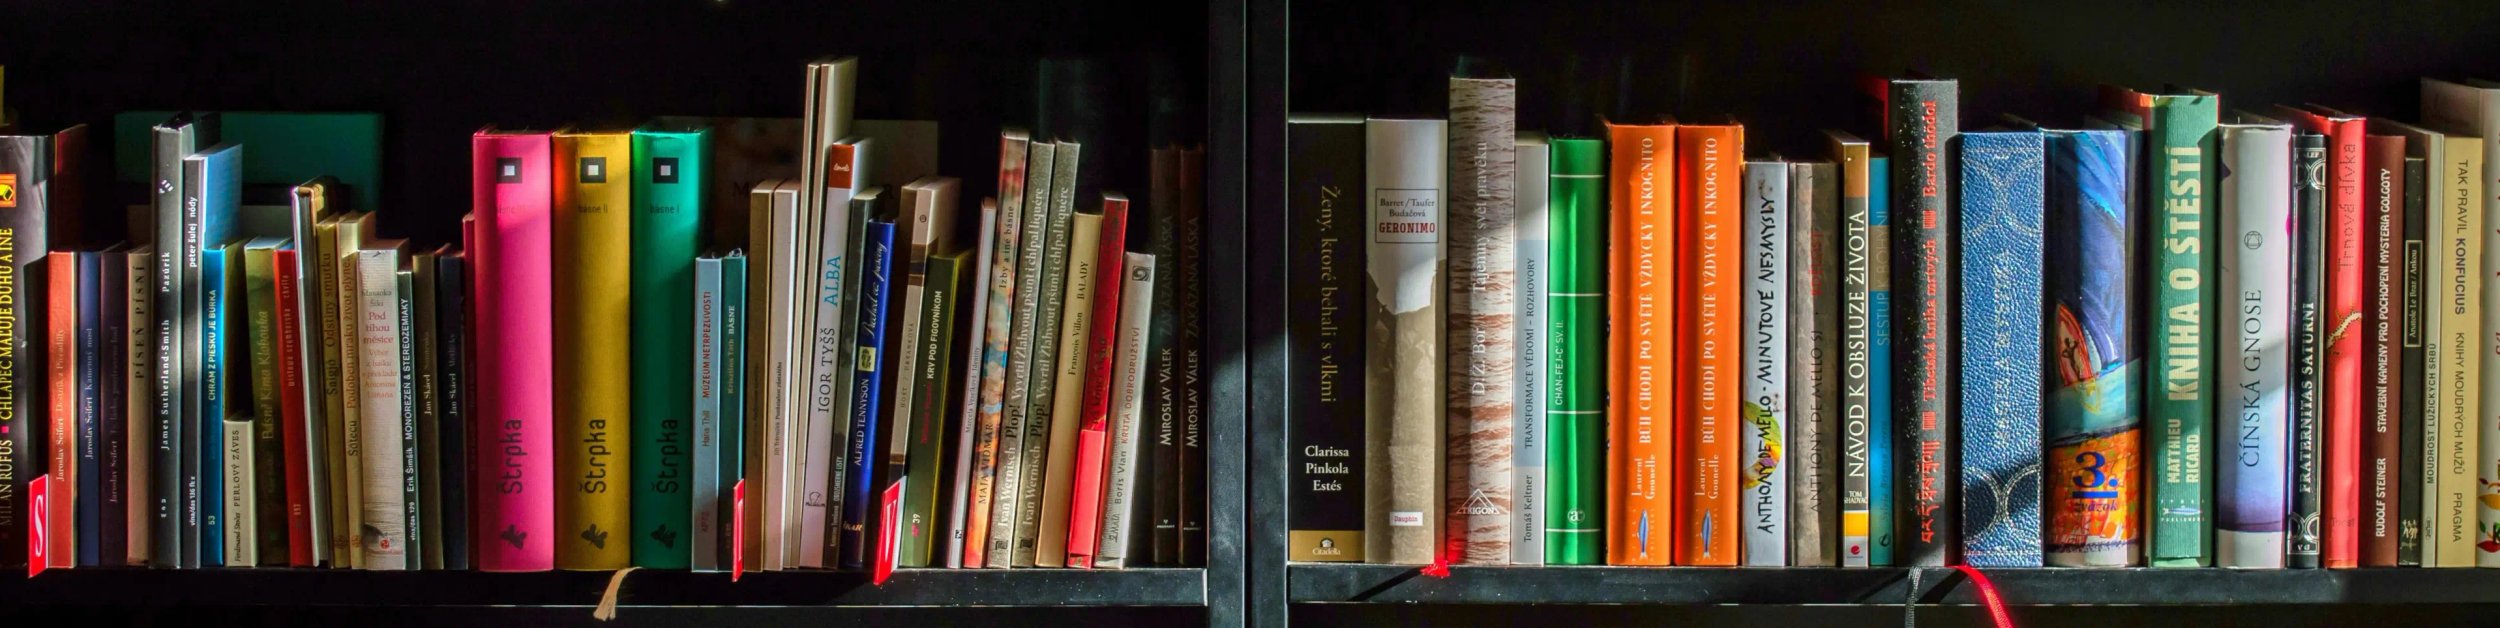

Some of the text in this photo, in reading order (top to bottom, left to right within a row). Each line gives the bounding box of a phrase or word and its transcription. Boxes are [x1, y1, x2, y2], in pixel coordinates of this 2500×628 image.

[1921, 151, 1937, 198] Bardo
[2336, 142, 2356, 273] Trnová dívka
[187, 196, 197, 268] peter šulej nódy
[1379, 222, 1436, 233] GERONIMO
[1389, 209, 1426, 217] Budačová
[321, 252, 332, 297] smutku
[1316, 184, 1341, 402] Ženy, ktoré behali s vlkmi
[1472, 233, 1489, 355] Bor Tajemný
[1637, 137, 1653, 411] CHODÍ PO SVĚTĚ VŽDYCKY INKOGNITO
[1700, 137, 1716, 411] CHODÍ PO SVĚTĚ VŽDYCKY INKOGNITO
[2162, 145, 2202, 401] KNIHA O ŠTĚSTÍ
[2408, 249, 2419, 338] Anatole Le Ankou
[133, 266, 144, 379] PÍSEŇ PÍSNÍ
[160, 251, 170, 451] James Sutherland-Smith Pazúrik
[208, 320, 217, 331] JE
[208, 331, 217, 363] PIESKU
[343, 324, 354, 359] mraku
[369, 311, 386, 321] Pod
[400, 298, 411, 372] STEREOZEMIAKY
[727, 305, 736, 335] BÁSNE
[817, 255, 841, 413] IGOR TYŠŠ ALBA
[1068, 261, 1089, 376] François Villon BALADY
[1843, 210, 1865, 478] NÁVOD K OBSLUZE ŽIVOTA
[1876, 292, 1889, 346] SESTUP
[1921, 239, 1940, 401] Tibetská kniha mrtvých
[2376, 168, 2392, 538] RUDOLF STEINER STAVEBNÍ KAMENY PRO POCHOPENÍ MYSTERIA GOLGOTY
[2453, 159, 2470, 543] TAK PRAVIL KONFUCIUS KNIHY MOUDRÝCH MUŽŮ PRAGMA
[207, 371, 217, 401] CHRÁM
[702, 291, 712, 447] Hans MÚZEUM NETRPEZLIVOSTI
[965, 346, 980, 433] Marcela Identity
[978, 206, 1014, 504] MAJA VIDMAR Izby iné básne
[1755, 194, 1778, 533] ANTHONY MELLO MINUTOVÉ NESMYSLY
[2238, 289, 2262, 469] ČÍNSKÁ GNOSE
[84, 397, 94, 460] Jaroslav Seifert
[402, 381, 413, 440] MONOREZEŇ
[423, 374, 432, 416] Jan Skácel
[448, 372, 458, 416] Jan Skácel
[854, 379, 870, 466] ALFRED TENNYSON
[912, 290, 941, 524] 39 KRV POD FIGOVNÍKOM
[1114, 326, 1140, 504] Boris Vian DOBRODRUŽSTVÍ
[1158, 347, 1172, 446] MIROSLAV VÁLEK
[1184, 348, 1199, 448] MIROSLAV VÁLEK
[1523, 258, 1536, 543] Tomáš Keltner TRANSFORMACE VĚDOMÍ ROZHOVORY
[1810, 346, 1823, 514] ANTHONY MELLO
[2298, 301, 2315, 494] FRATERNITAS SATURNI
[2424, 371, 2437, 484] MOUDROST LUŽICKÝCH
[55, 418, 64, 482] Jaroslav Seifert
[229, 430, 240, 507] PERLOVÝ ZÁVES
[406, 476, 414, 493] Erik
[496, 419, 528, 494] Štrpka
[577, 419, 611, 494] Štrpka
[651, 419, 684, 494] Štrpka
[998, 404, 1023, 527] Ivan Wernisch Plop!
[1022, 403, 1048, 526] Ivan Wernisch Plop!
[1304, 445, 1350, 457] Clarissa
[1305, 462, 1349, 474] Pinkola
[1312, 479, 1342, 491] Estés
[1634, 457, 1644, 498] Laurent
[1645, 454, 1656, 500] Gounelle
[1697, 457, 1707, 498] Laurent
[1708, 454, 1719, 500] Gounelle
[2072, 451, 2118, 488] 3.
[2166, 418, 2182, 483] MATTHIEU
[2185, 433, 2201, 483] RICARD
[1461, 507, 1497, 515] TRIGON
